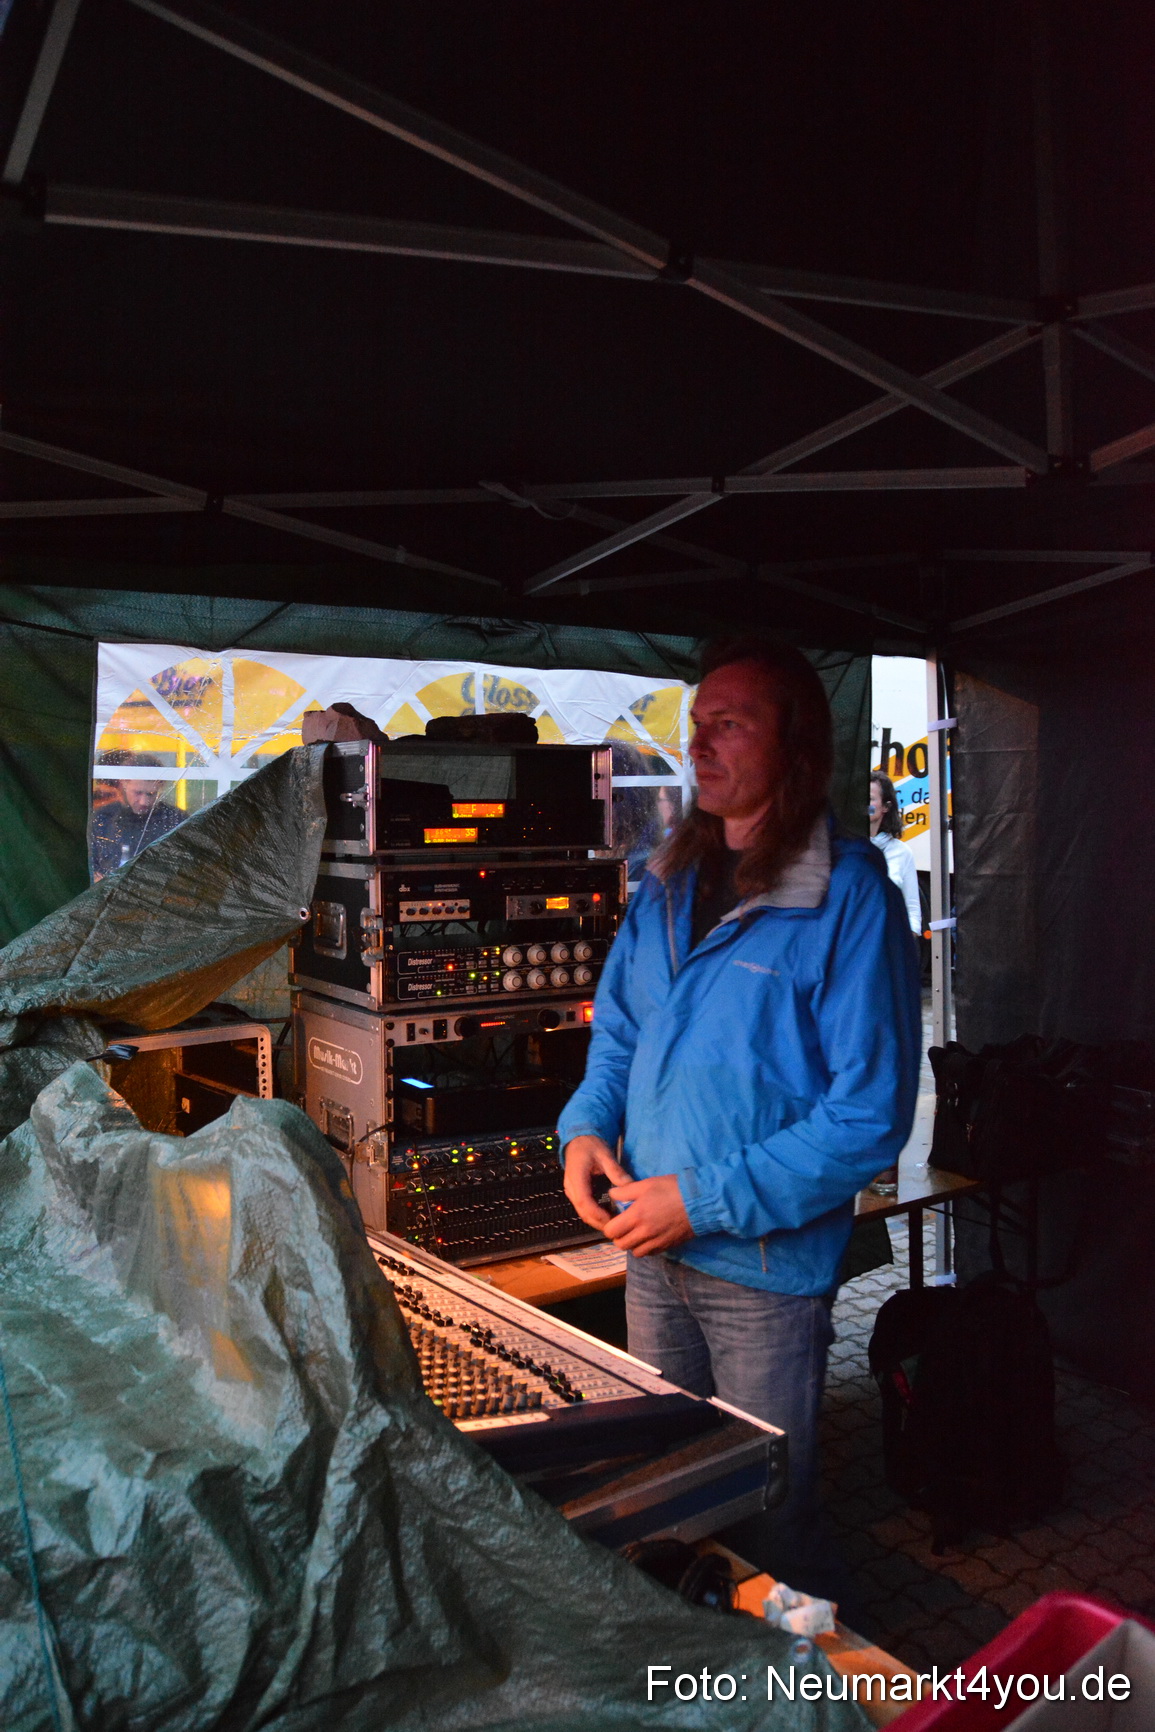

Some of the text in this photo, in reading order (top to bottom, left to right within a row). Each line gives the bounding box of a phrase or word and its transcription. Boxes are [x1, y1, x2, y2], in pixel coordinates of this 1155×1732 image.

[398, 884, 411, 893] dbx
[407, 958, 433, 967] Distressor
[407, 983, 433, 992] Distressor
